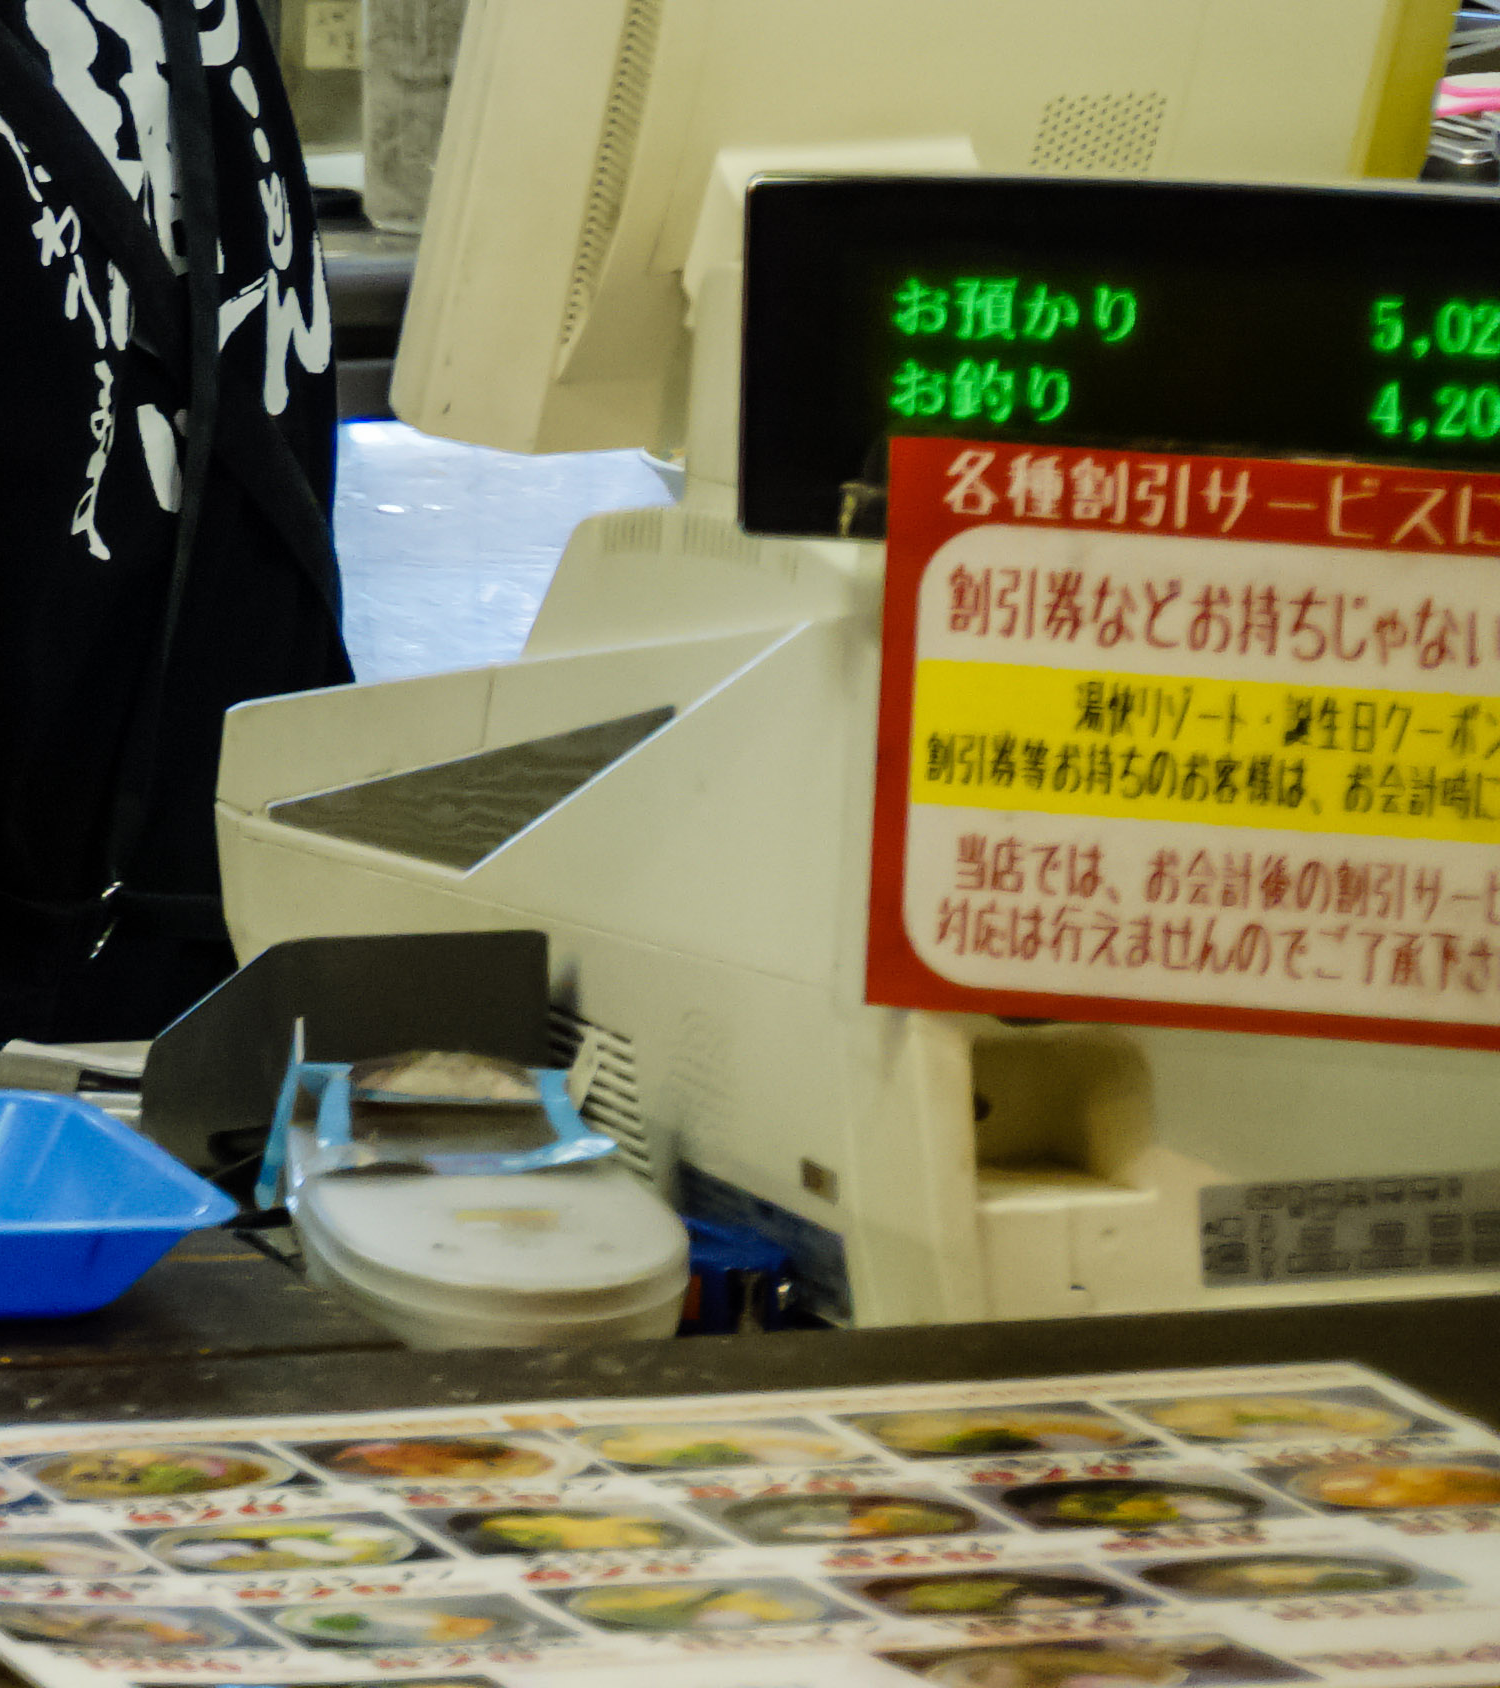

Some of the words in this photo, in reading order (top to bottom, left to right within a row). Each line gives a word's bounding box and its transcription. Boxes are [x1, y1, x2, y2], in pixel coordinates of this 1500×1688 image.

[891, 276, 1138, 343] お預かり
[888, 357, 1071, 424] お釣り
